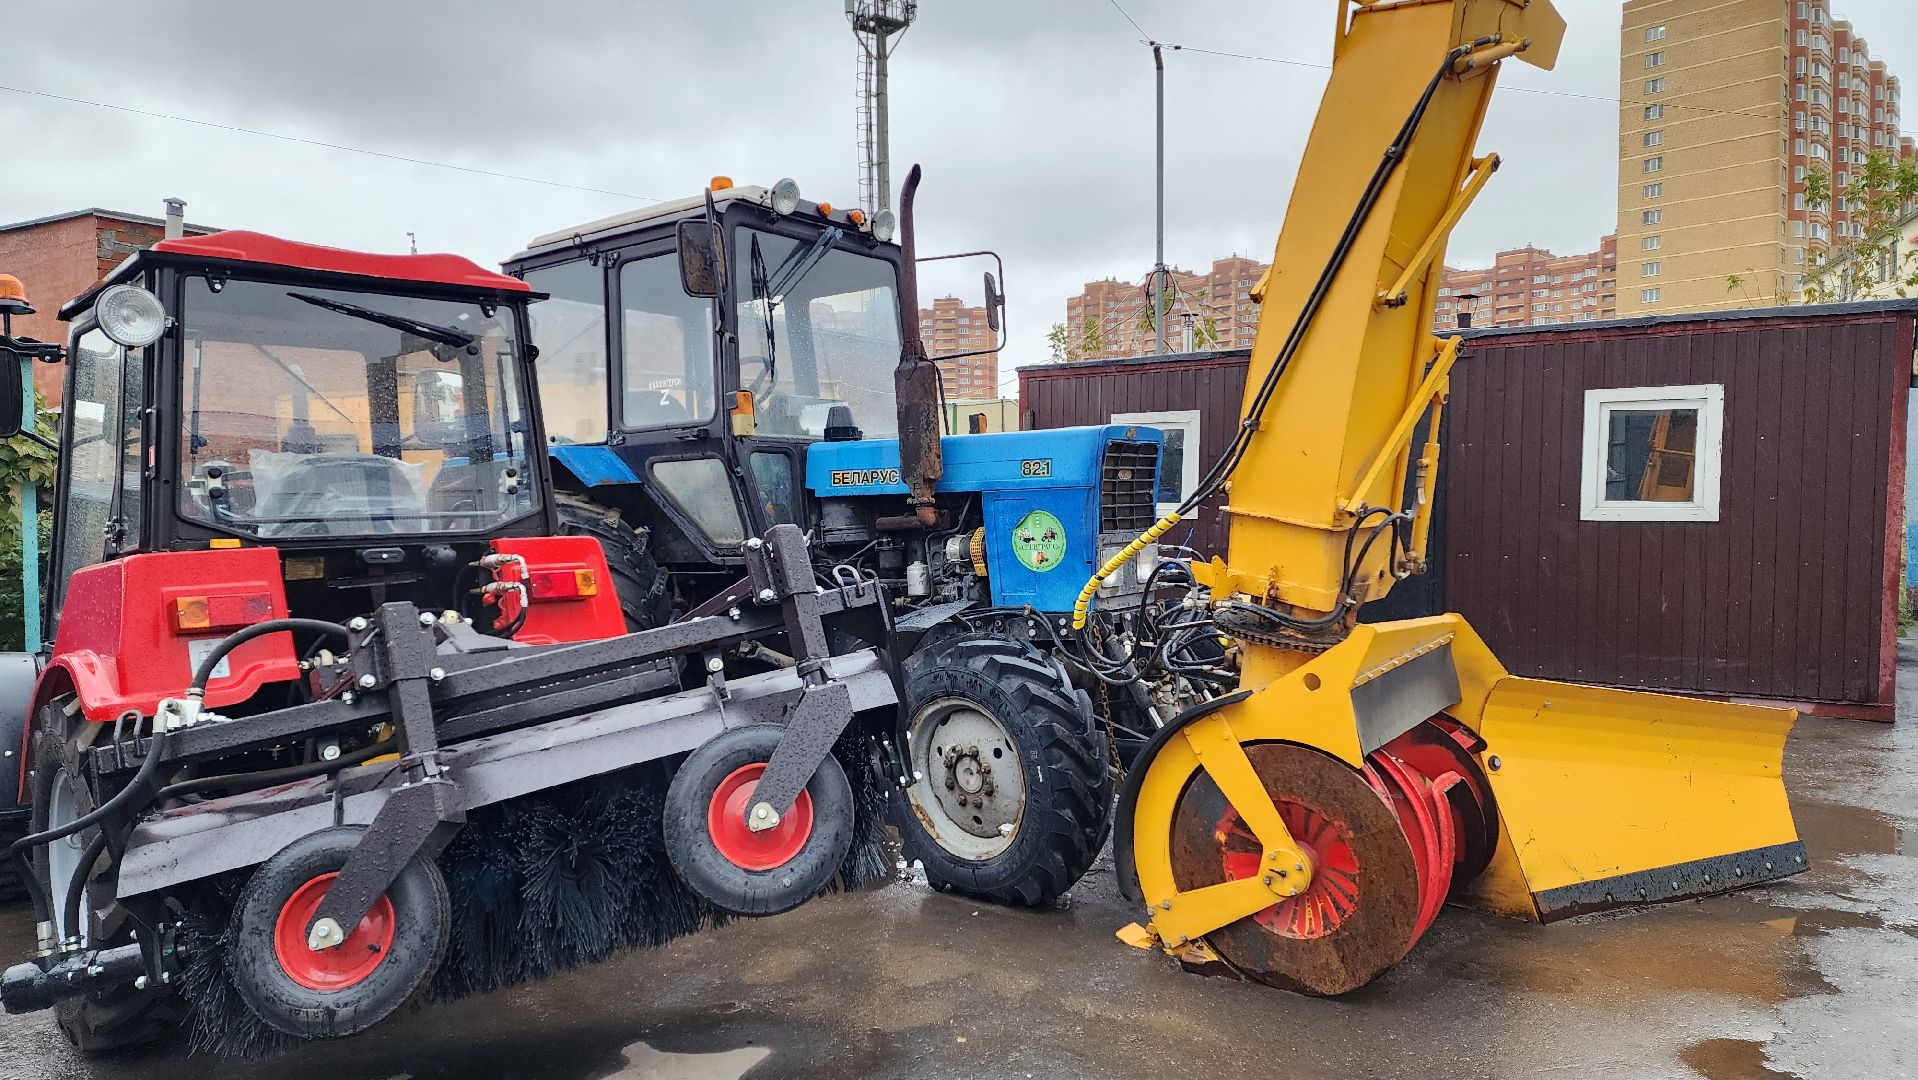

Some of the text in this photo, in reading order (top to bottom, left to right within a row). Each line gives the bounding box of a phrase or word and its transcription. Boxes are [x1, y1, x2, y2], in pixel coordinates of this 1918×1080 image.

[660, 389, 670, 405] Z
[1022, 460, 1050, 476] 82.1
[832, 469, 899, 486] БЕЛАРУС
